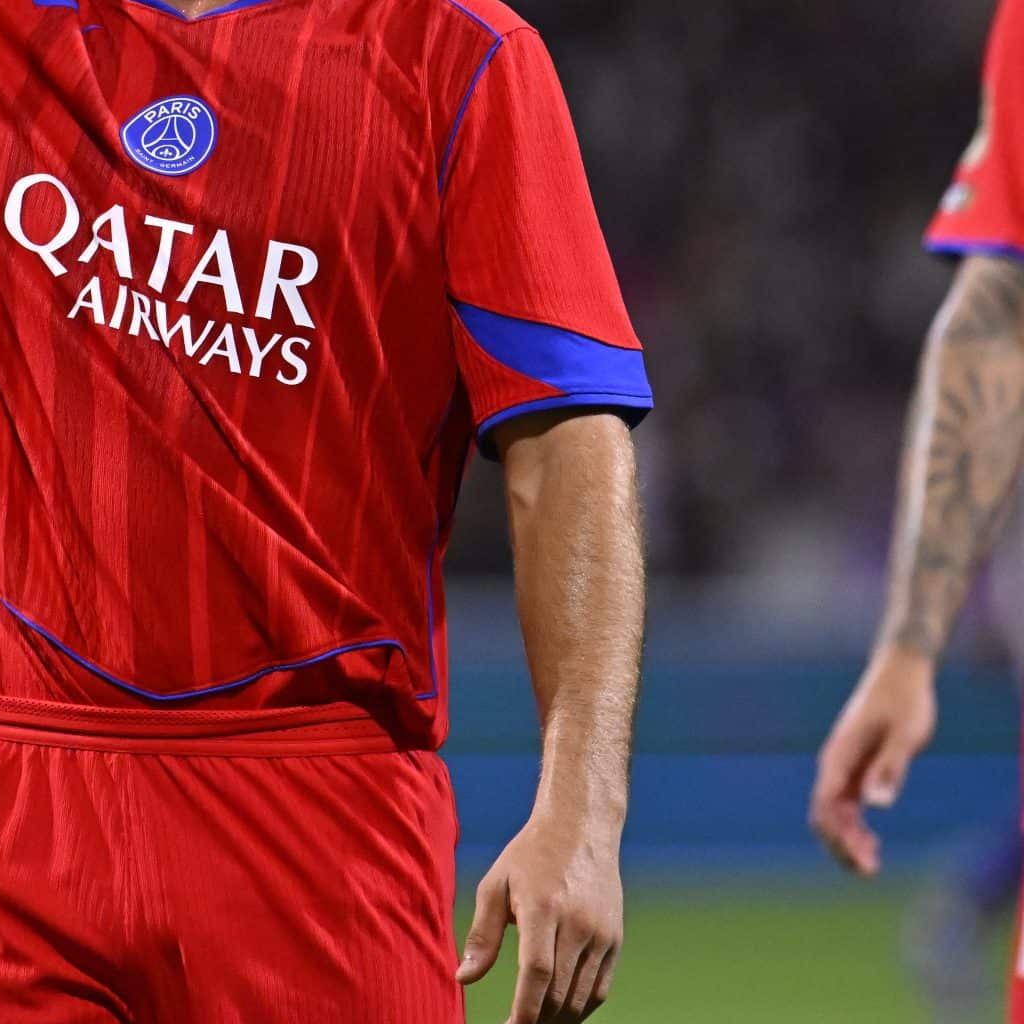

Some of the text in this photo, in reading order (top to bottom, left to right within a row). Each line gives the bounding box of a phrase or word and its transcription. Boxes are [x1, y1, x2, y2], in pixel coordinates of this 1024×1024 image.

[144, 102, 202, 123] PARIS
[4, 173, 318, 329] QATAR
[67, 276, 311, 386] AIRWAYS
